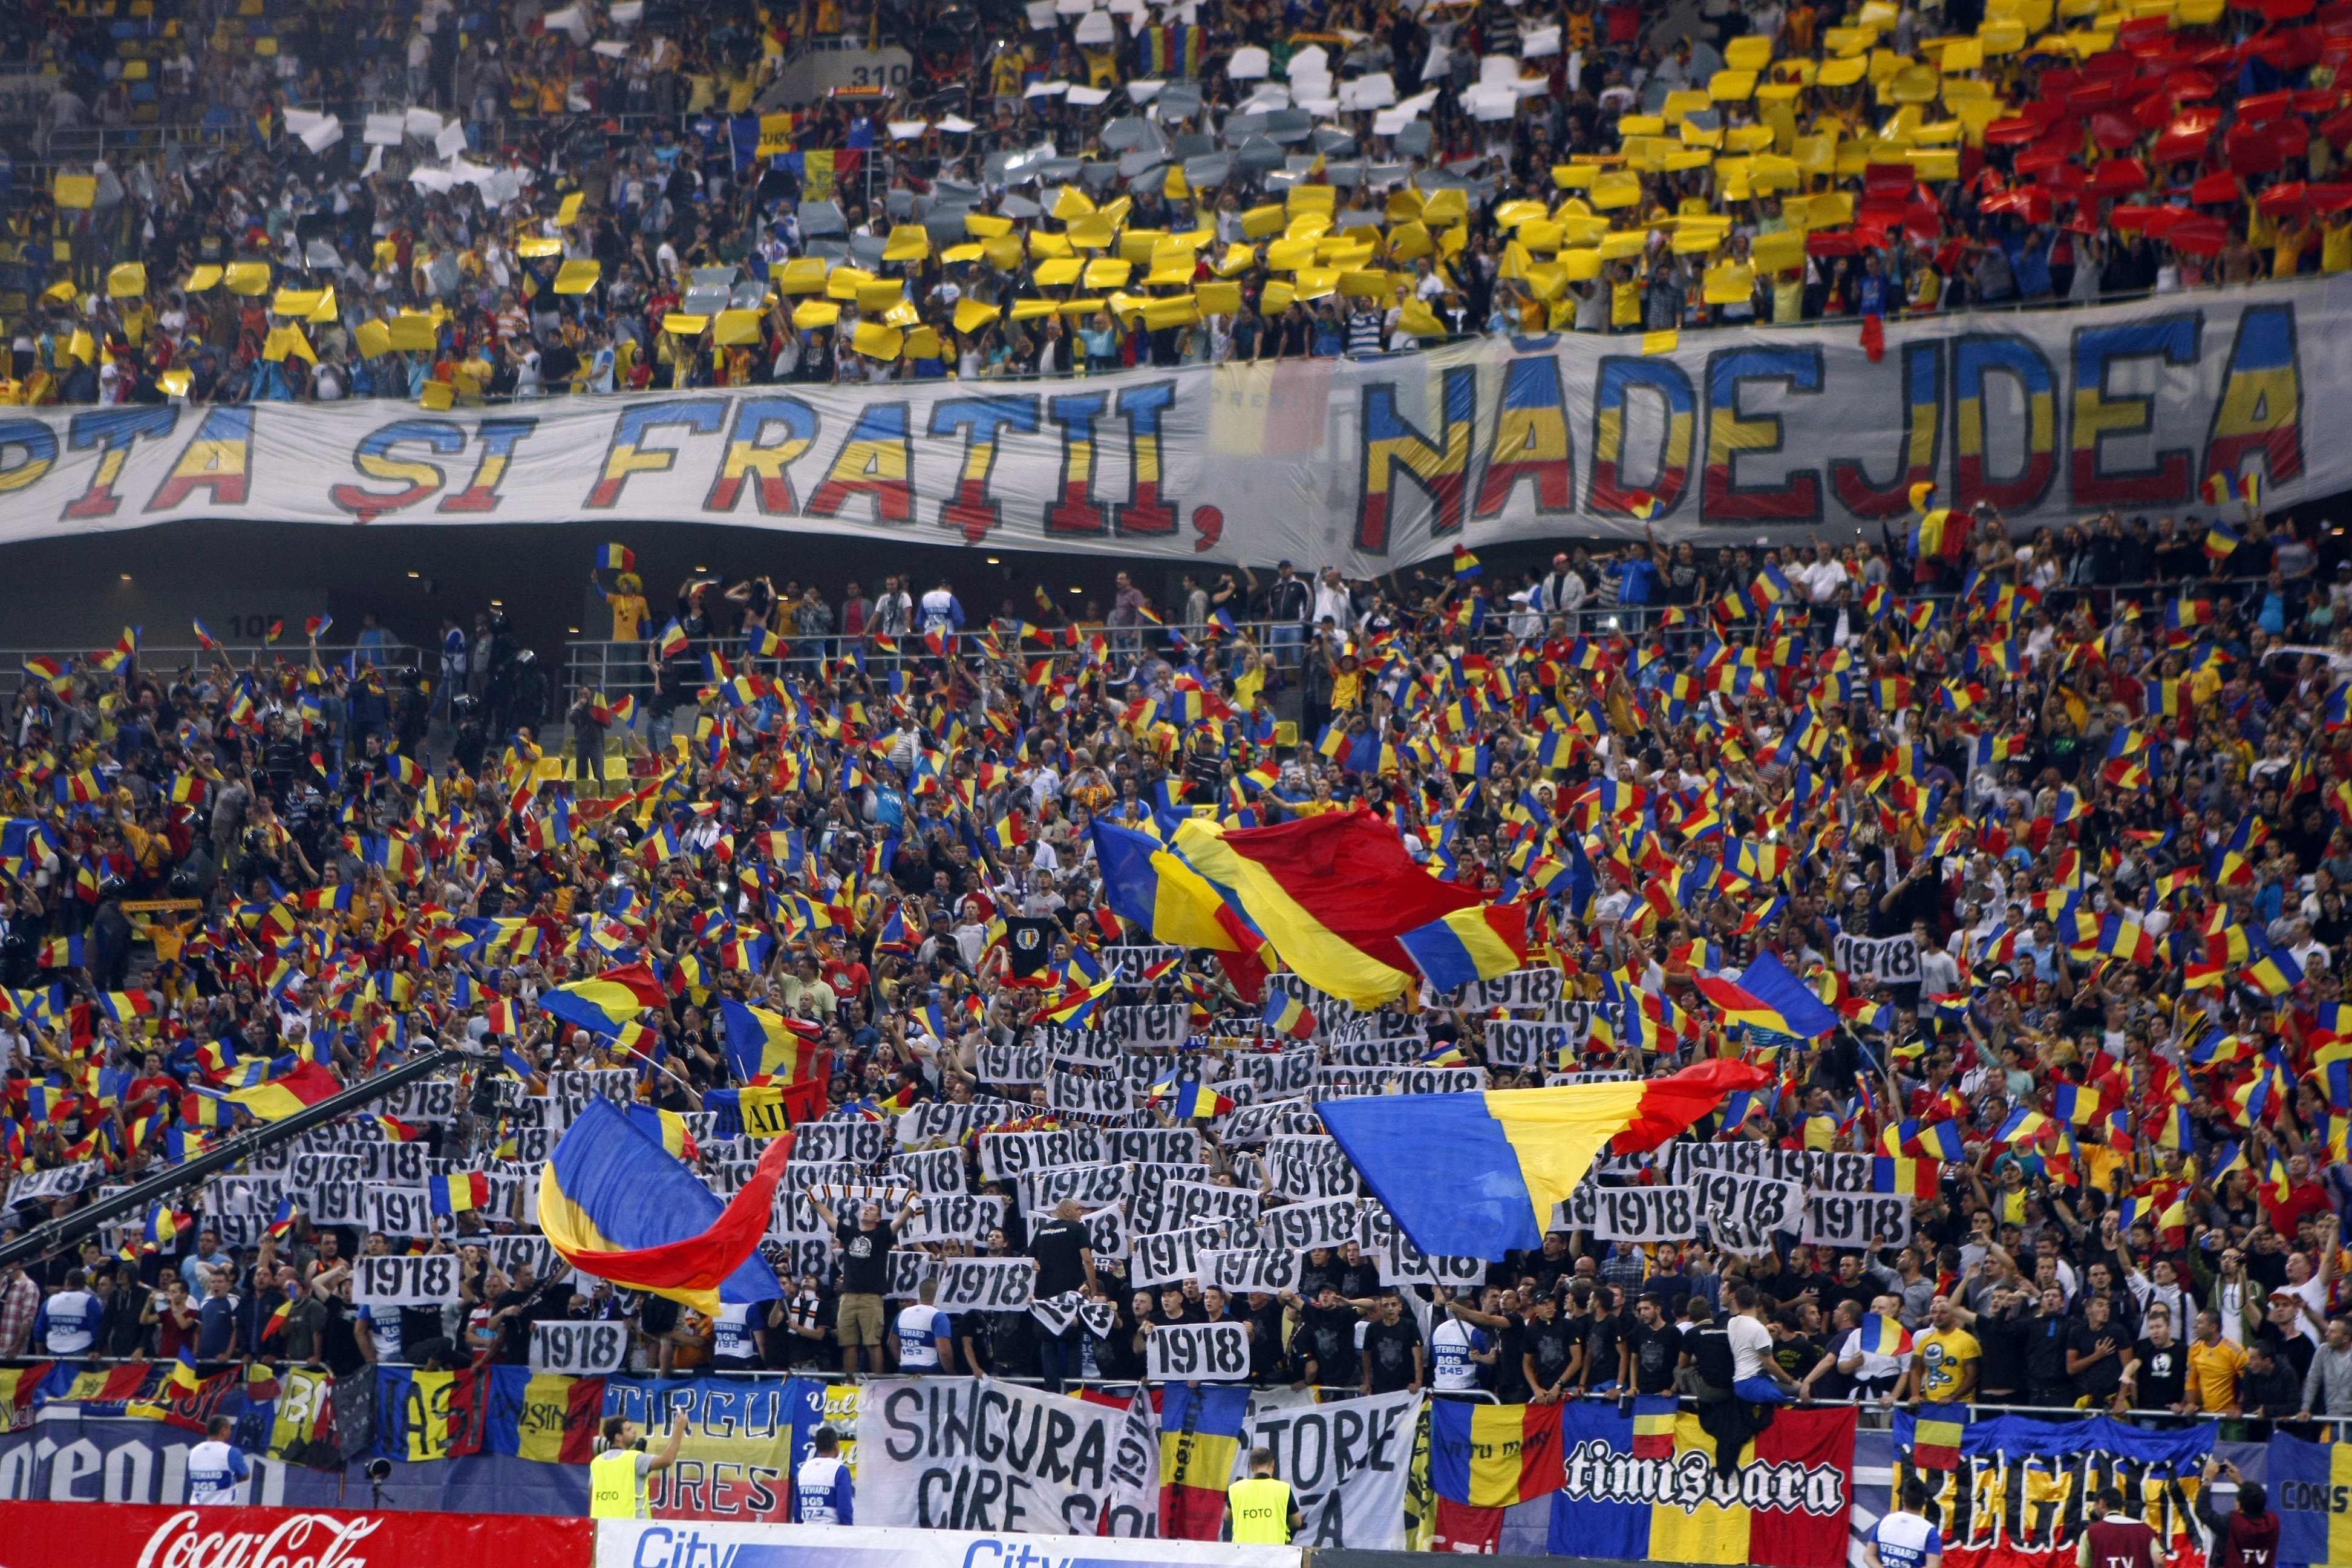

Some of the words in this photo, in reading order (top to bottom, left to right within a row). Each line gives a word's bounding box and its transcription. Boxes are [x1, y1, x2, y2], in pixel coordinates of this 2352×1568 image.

[852, 65, 907, 87] 310
[1838, 938, 1916, 978] 1918
[1053, 1074, 1126, 1111] 1918
[338, 1142, 423, 1180] 918
[985, 1135, 1070, 1174] 1918
[1106, 1131, 1194, 1163] 1918
[1676, 1142, 1761, 1184] 1918
[11, 1163, 87, 1202] 1918
[893, 1151, 961, 1193] 1918
[1042, 1165, 1123, 1206] 1918
[1275, 1153, 1355, 1198] 1918
[1766, 1150, 1863, 1192] 1918
[313, 1181, 365, 1220] 191
[1601, 1189, 1692, 1235] 1918
[1694, 1172, 1788, 1225] 1918
[1265, 1201, 1356, 1249] 1918
[1811, 1196, 1904, 1244] 1918
[358, 1257, 451, 1297] 1918
[944, 1263, 1033, 1307] 1918
[1215, 1249, 1295, 1288] 1918
[376, 1317, 402, 1325] STEWA
[381, 1326, 400, 1335] BG
[714, 1323, 742, 1332] TEWARD
[899, 1329, 925, 1338] TEWARD
[535, 1326, 618, 1368] 1918
[1152, 1328, 1245, 1373] 1918
[1435, 1346, 1467, 1354] STEWARD
[1437, 1356, 1462, 1365] BGS
[884, 1380, 1106, 1489] SINGURA
[595, 1490, 619, 1501] FOTO
[801, 1497, 825, 1506] BGS
[1243, 1508, 1272, 1520] FOTO
[2280, 1480, 2352, 1514] CONS
[633, 1526, 737, 1568] City
[1880, 1543, 1919, 1560] STEWARD
[2241, 1549, 2269, 1566] TV
